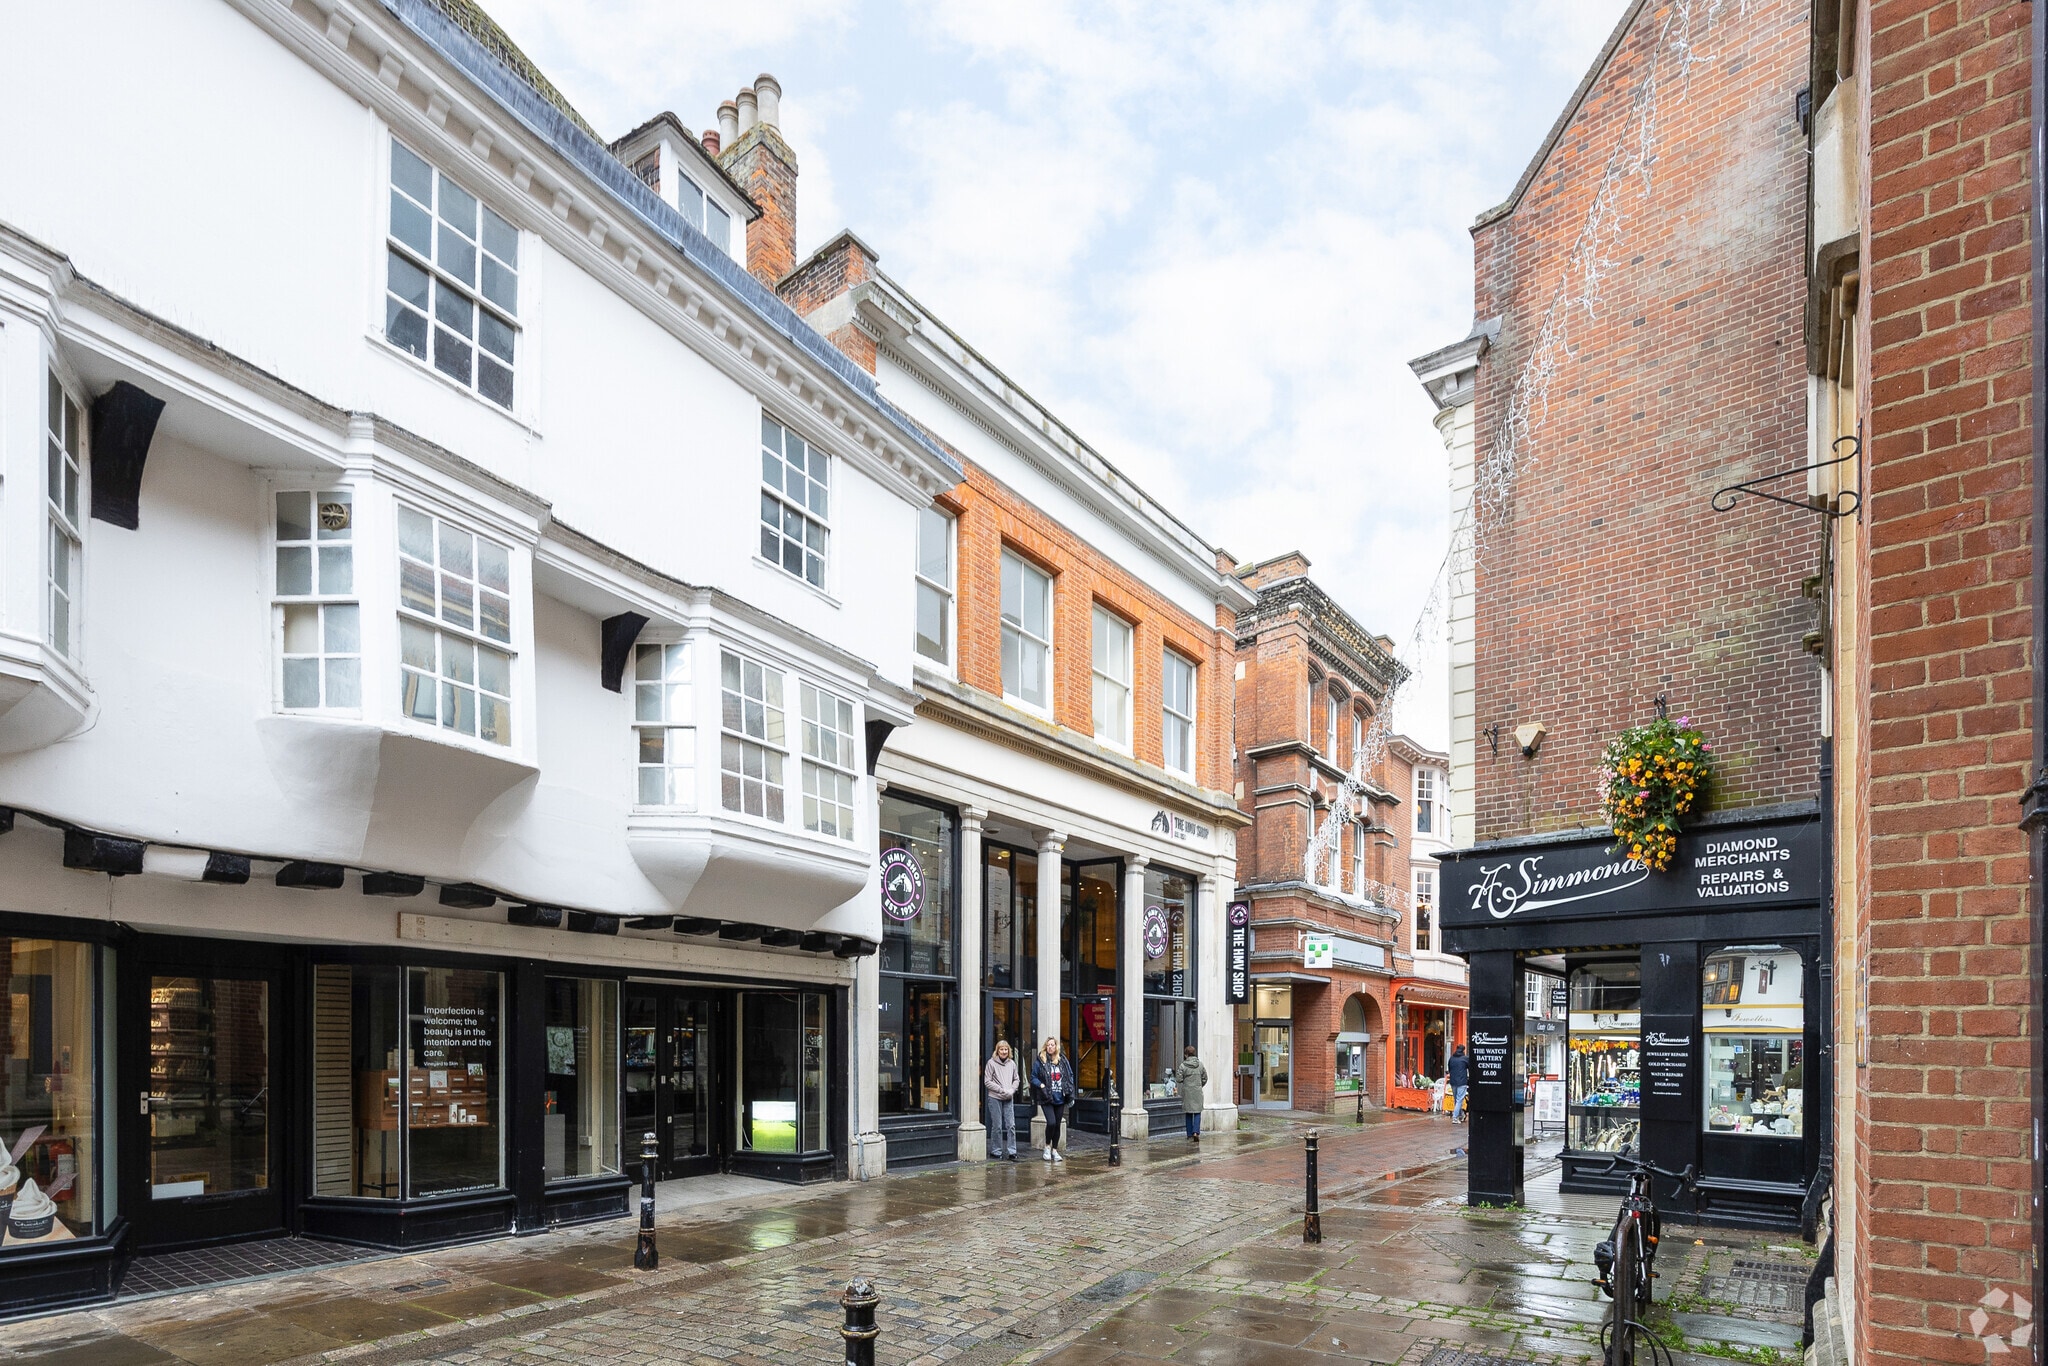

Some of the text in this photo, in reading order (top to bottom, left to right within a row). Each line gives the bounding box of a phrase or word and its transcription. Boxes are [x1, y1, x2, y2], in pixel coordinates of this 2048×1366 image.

[1706, 837, 1778, 854] DIAMOND
[1695, 849, 1790, 868] MERCHANTS
[887, 853, 906, 863] HMV
[906, 859, 921, 887] SHOP
[1701, 868, 1784, 885] REPAIRS &
[1697, 881, 1790, 898] VALUATIONS
[884, 898, 916, 916] EST. 1921
[1233, 928, 1244, 947] THE
[1233, 949, 1244, 970] HMV
[1233, 972, 1244, 998] SHOP
[424, 1006, 476, 1015] Imperfection
[424, 1017, 463, 1026] welcome;
[424, 1027, 486, 1037] beauty is in the
[424, 1038, 492, 1046] intention and the
